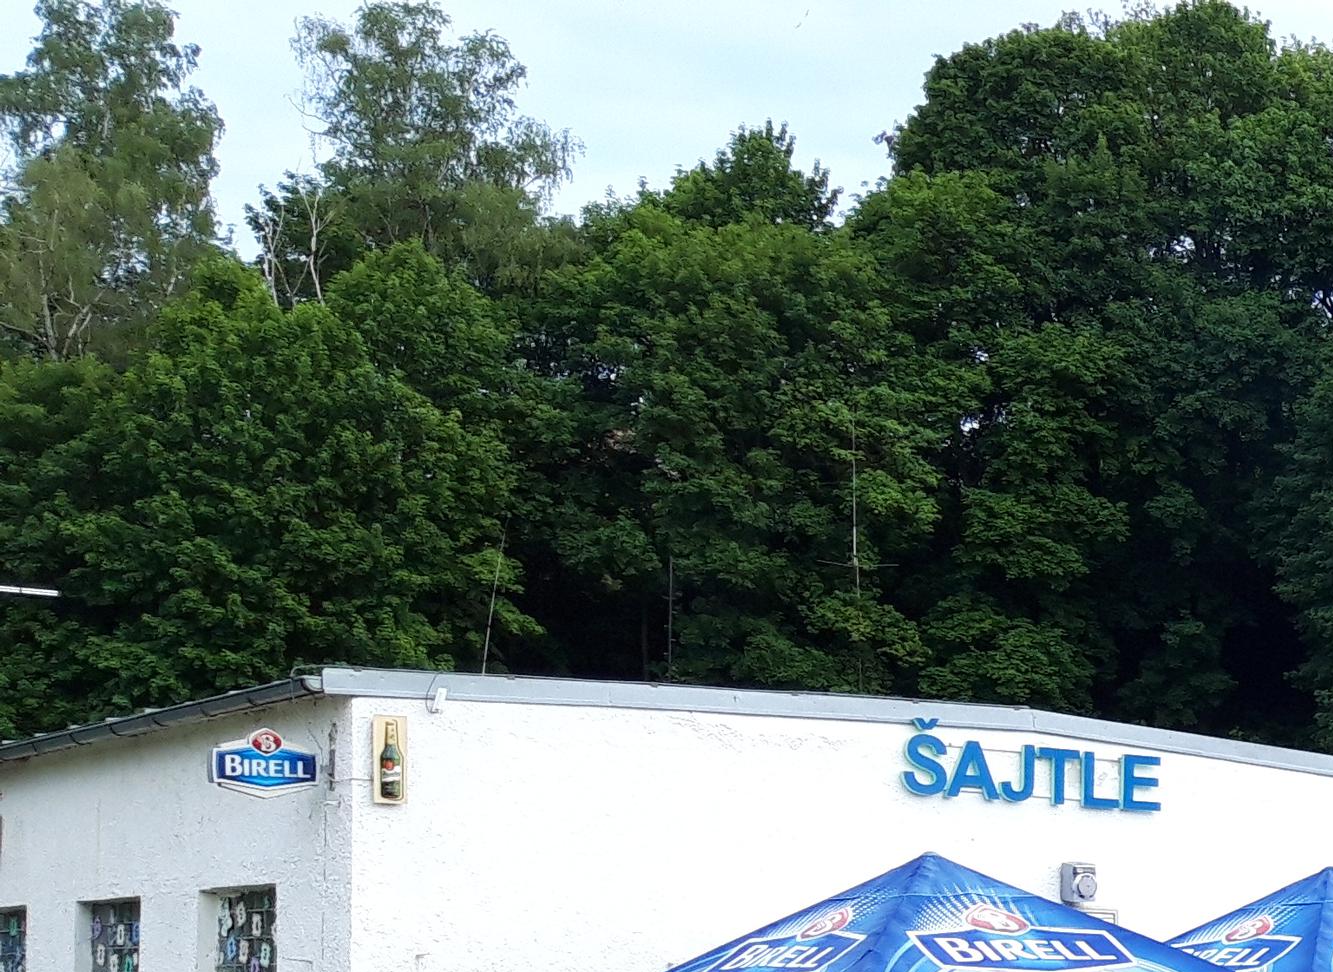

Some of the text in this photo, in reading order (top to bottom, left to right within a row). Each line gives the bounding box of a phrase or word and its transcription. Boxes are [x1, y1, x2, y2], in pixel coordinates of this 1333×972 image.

[225, 754, 311, 779] BIRELL
[901, 717, 1161, 811] ŠAJTLE
[720, 944, 834, 970] BIRELL
[934, 936, 1117, 963] BIRELL
